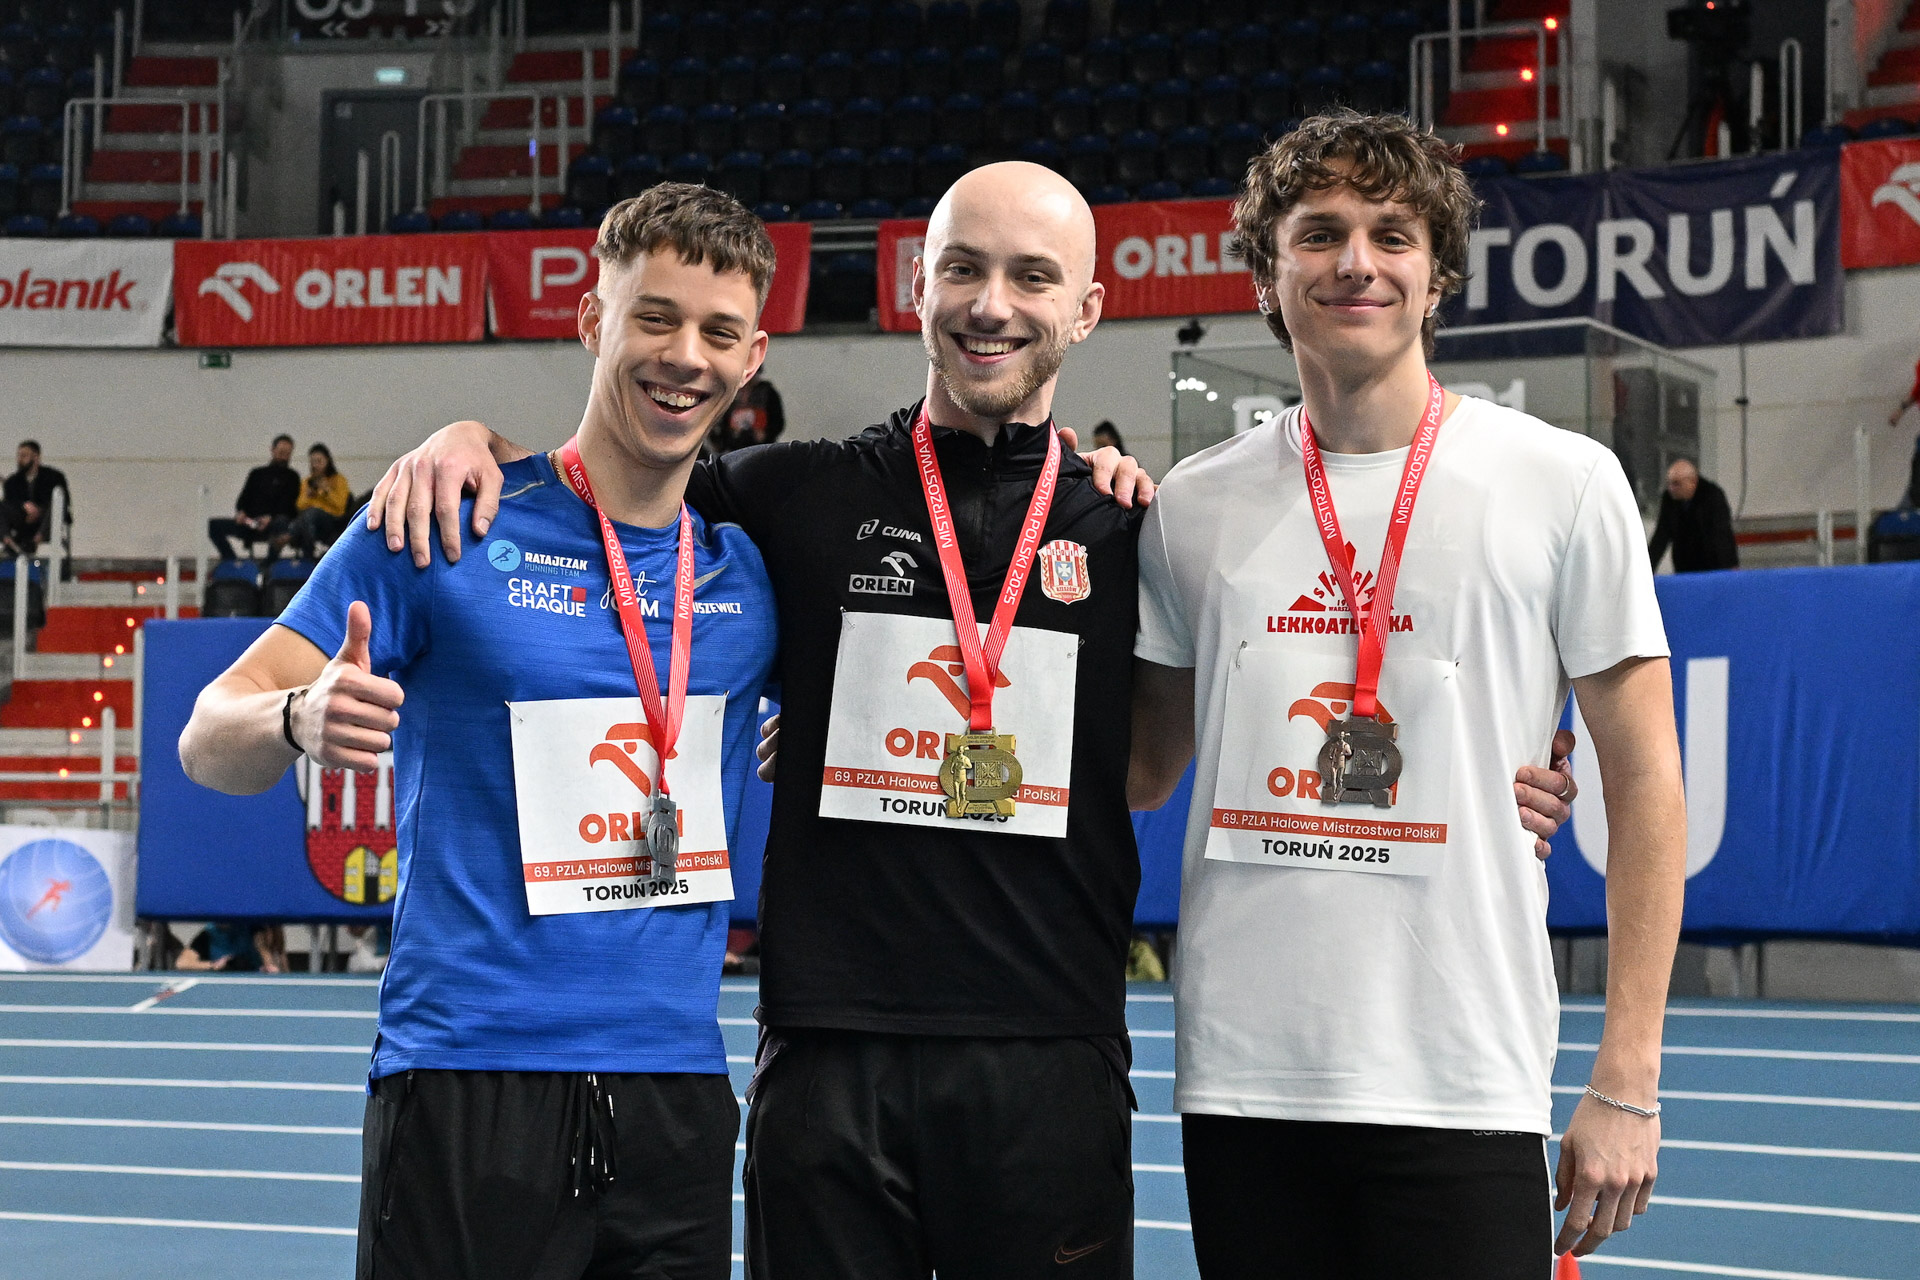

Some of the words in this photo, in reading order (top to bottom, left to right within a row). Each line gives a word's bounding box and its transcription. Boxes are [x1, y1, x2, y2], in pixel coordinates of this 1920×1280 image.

[1465, 171, 1816, 311] TORUŃ
[1112, 230, 1250, 280] ORLE
[294, 265, 462, 310] ORLEN
[1396, 426, 1434, 524] MISTRZOSTWA
[919, 442, 953, 549] MISTRZOSTWA
[1303, 441, 1338, 540] MISTRZOSTWA
[882, 525, 922, 543] CUNA
[1015, 519, 1041, 570] POLSKI
[525, 552, 588, 571] RATAJCZAK
[525, 563, 558, 575] RUNNING
[561, 568, 580, 578] TEAM
[678, 521, 692, 620] MISTRZOSTWA
[508, 577, 572, 601] CRAFT
[851, 577, 913, 594] ORLEN
[1003, 570, 1024, 606] 2025
[508, 592, 587, 618] CHAQUE
[692, 602, 742, 614] USZEWICZ
[1266, 615, 1414, 635] LEKKOATLEKA
[834, 770, 853, 784] 69.
[856, 773, 886, 786] PZLA
[889, 775, 938, 791] Halowe
[1022, 788, 1061, 803] Polski
[579, 809, 684, 844] ORL
[1222, 813, 1239, 826] 69.
[1241, 814, 1268, 828] PZLA
[1270, 816, 1319, 832] Halowe
[1322, 821, 1401, 838] Mistrzostwa
[1405, 826, 1440, 839] Polski
[1262, 839, 1334, 860] TORUŃ
[1338, 845, 1390, 864] 2025
[533, 866, 554, 878] 69.
[556, 863, 586, 877] PZLA
[589, 860, 633, 875] Halowe
[694, 853, 723, 866] Polski
[582, 878, 646, 902] TORUŃ
[649, 879, 689, 897] 2025
